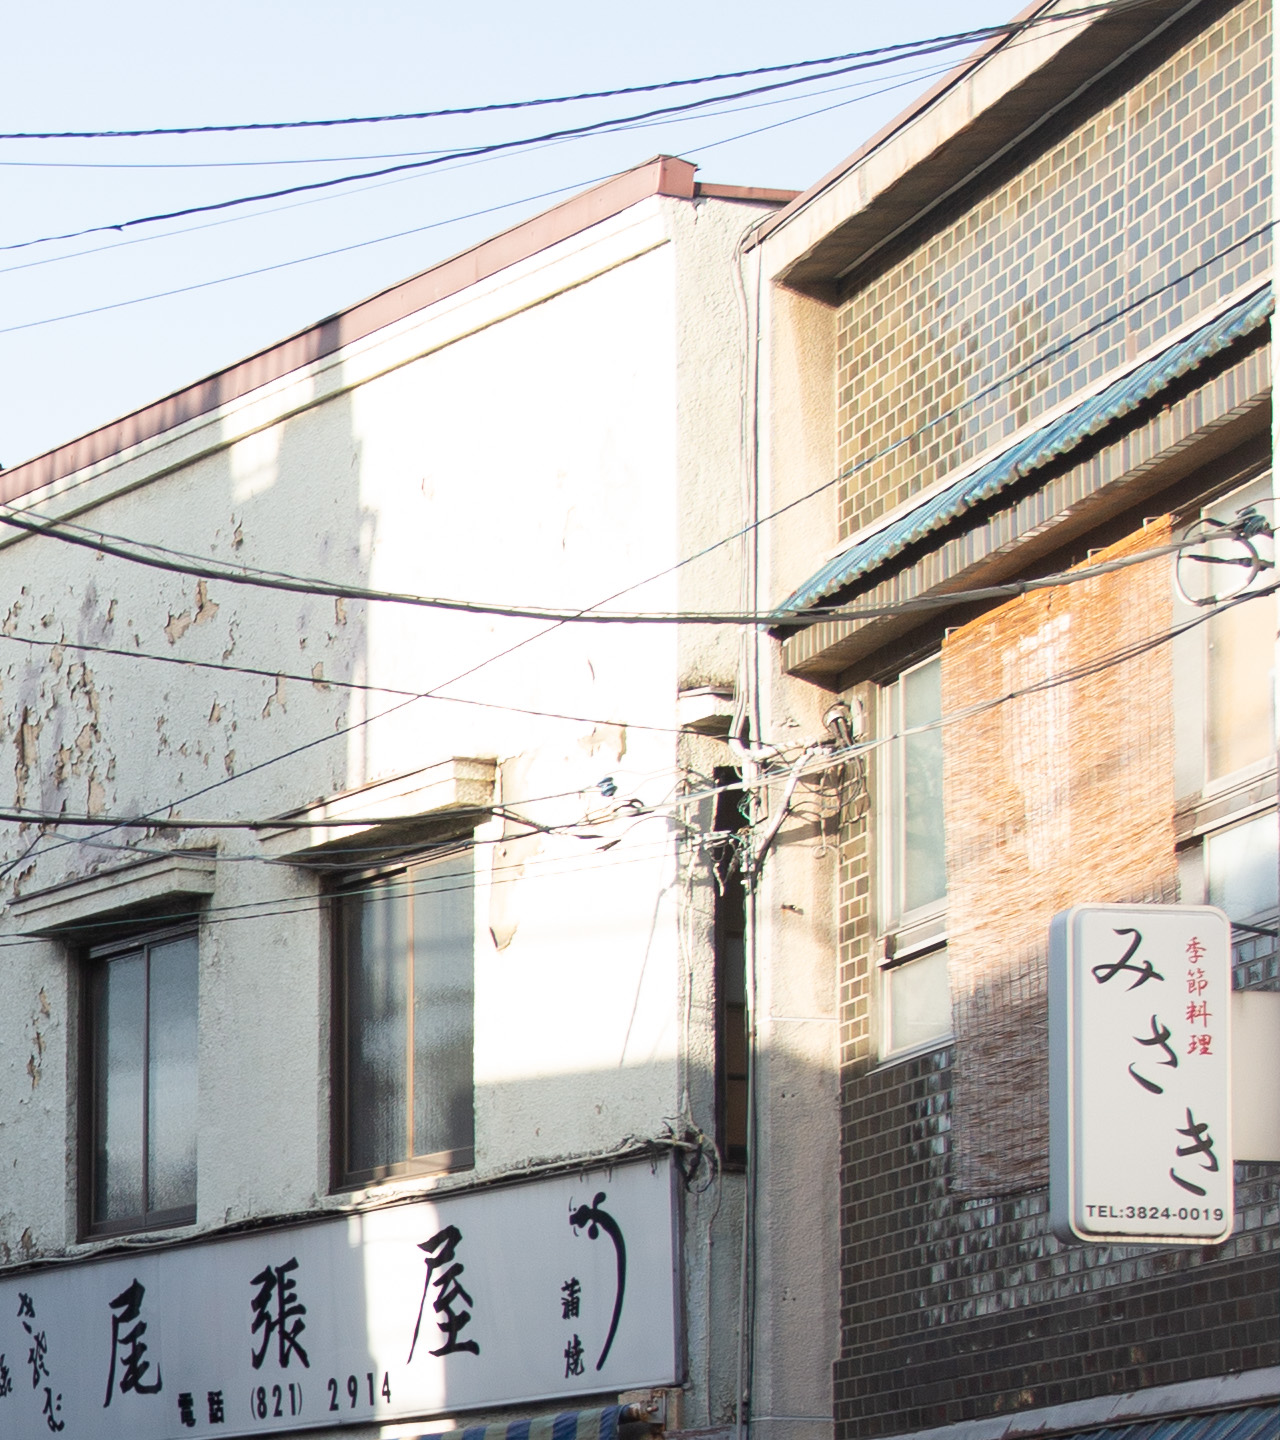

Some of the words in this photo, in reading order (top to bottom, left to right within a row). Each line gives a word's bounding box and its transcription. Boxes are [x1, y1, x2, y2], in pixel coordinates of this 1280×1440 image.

[1185, 936, 1214, 1056] 季節料理
[1091, 927, 1219, 1197] みさき
[1084, 1203, 1225, 1222] TEL:3824-0019
[103, 1224, 481, 1408] 尾張屋
[560, 1277, 585, 1379] 蒲焼
[177, 1391, 225, 1427] 電話
[250, 1382, 303, 1422] (821)
[327, 1371, 394, 1410] 2914
